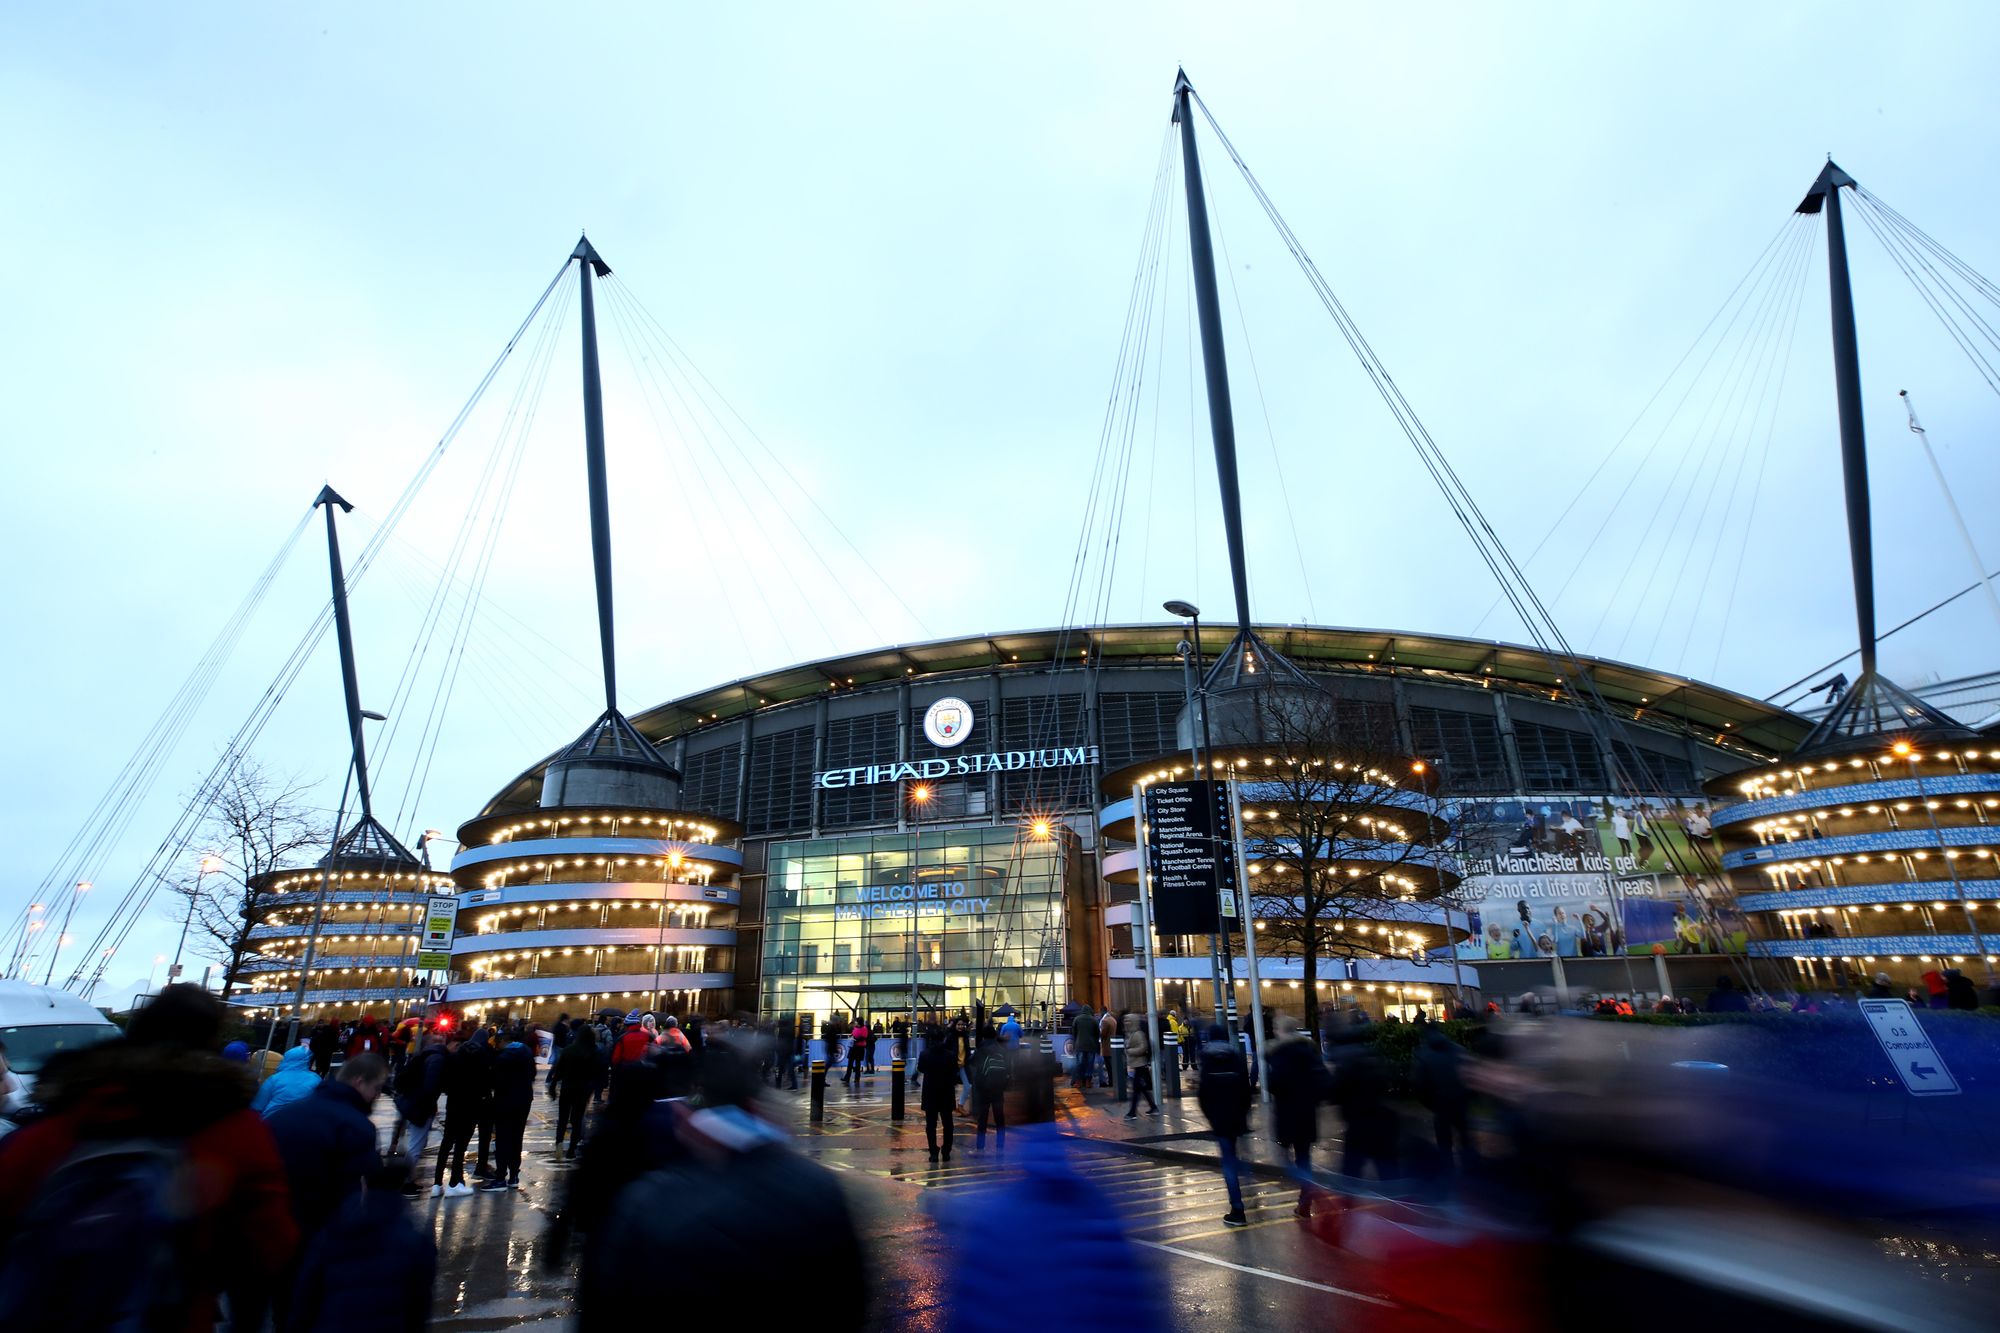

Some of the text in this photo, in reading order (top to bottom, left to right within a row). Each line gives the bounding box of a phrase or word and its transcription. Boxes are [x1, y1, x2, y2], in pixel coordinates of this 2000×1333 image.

[821, 747, 1086, 789] ETIHAD STADIUM
[1159, 825, 1193, 833] Manchester
[1159, 831, 1184, 839] Regional
[1160, 848, 1183, 856] Squash
[1495, 852, 1579, 873] Manchester
[1580, 851, 1612, 872] kids
[1614, 852, 1639, 876] get
[1162, 874, 1182, 882] Health
[1163, 879, 1206, 888] Fitness Centre
[1493, 880, 1527, 898] shot
[1529, 880, 1546, 898] at
[1546, 877, 1570, 898] life
[1571, 878, 1592, 897] for
[1615, 879, 1654, 900] years
[855, 881, 965, 902] WELCOME TO
[433, 901, 454, 909] STOP
[834, 898, 990, 920] MANCHESTER CITY
[1346, 962, 1353, 978] T
[433, 989, 446, 1001] V
[1885, 1041, 1929, 1050] Compound
